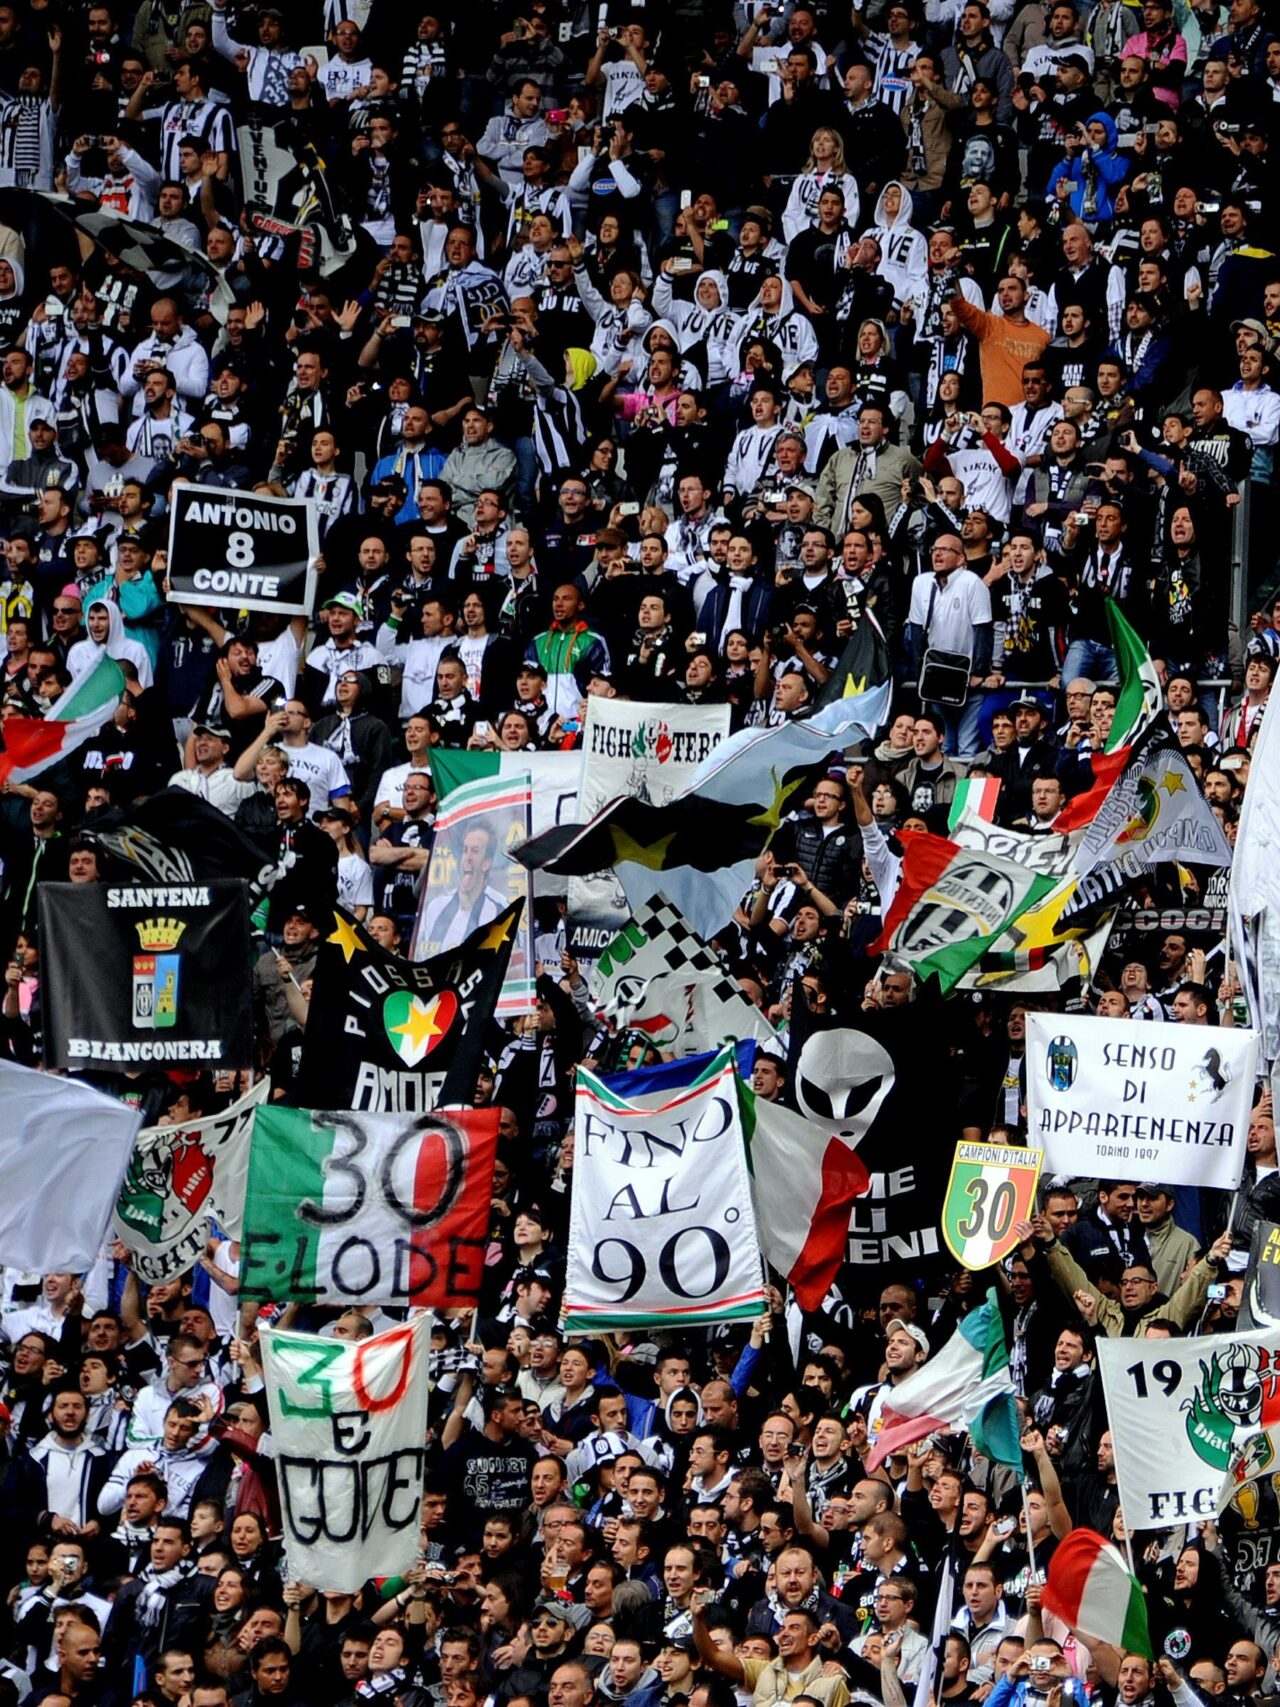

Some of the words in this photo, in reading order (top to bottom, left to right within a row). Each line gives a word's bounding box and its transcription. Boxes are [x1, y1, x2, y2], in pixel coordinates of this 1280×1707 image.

[184, 501, 297, 535] ANTONIO
[225, 531, 255, 568] 8
[192, 568, 280, 598] CONTE
[106, 886, 212, 908] SANTENA
[67, 1038, 222, 1062] BIANCONERA
[1103, 1043, 1176, 1071] SENSO
[350, 1060, 448, 1114] AMOR
[1122, 1079, 1147, 1104] DI
[583, 1096, 734, 1169] FINO
[1038, 1107, 1235, 1148] APPARTENENZA
[299, 1109, 471, 1230] 30
[958, 1144, 1000, 1163] CAMPIONI
[1002, 1148, 1038, 1167] D'ITALIA
[1096, 1144, 1130, 1159] TORINO
[1134, 1148, 1160, 1161] 1897
[602, 1173, 700, 1221] AL
[958, 1177, 1017, 1242] 30
[1262, 1246, 1272, 1262] E
[272, 1328, 415, 1419] 30
[1126, 1359, 1183, 1398] 19
[1148, 1486, 1219, 1520] FIG
